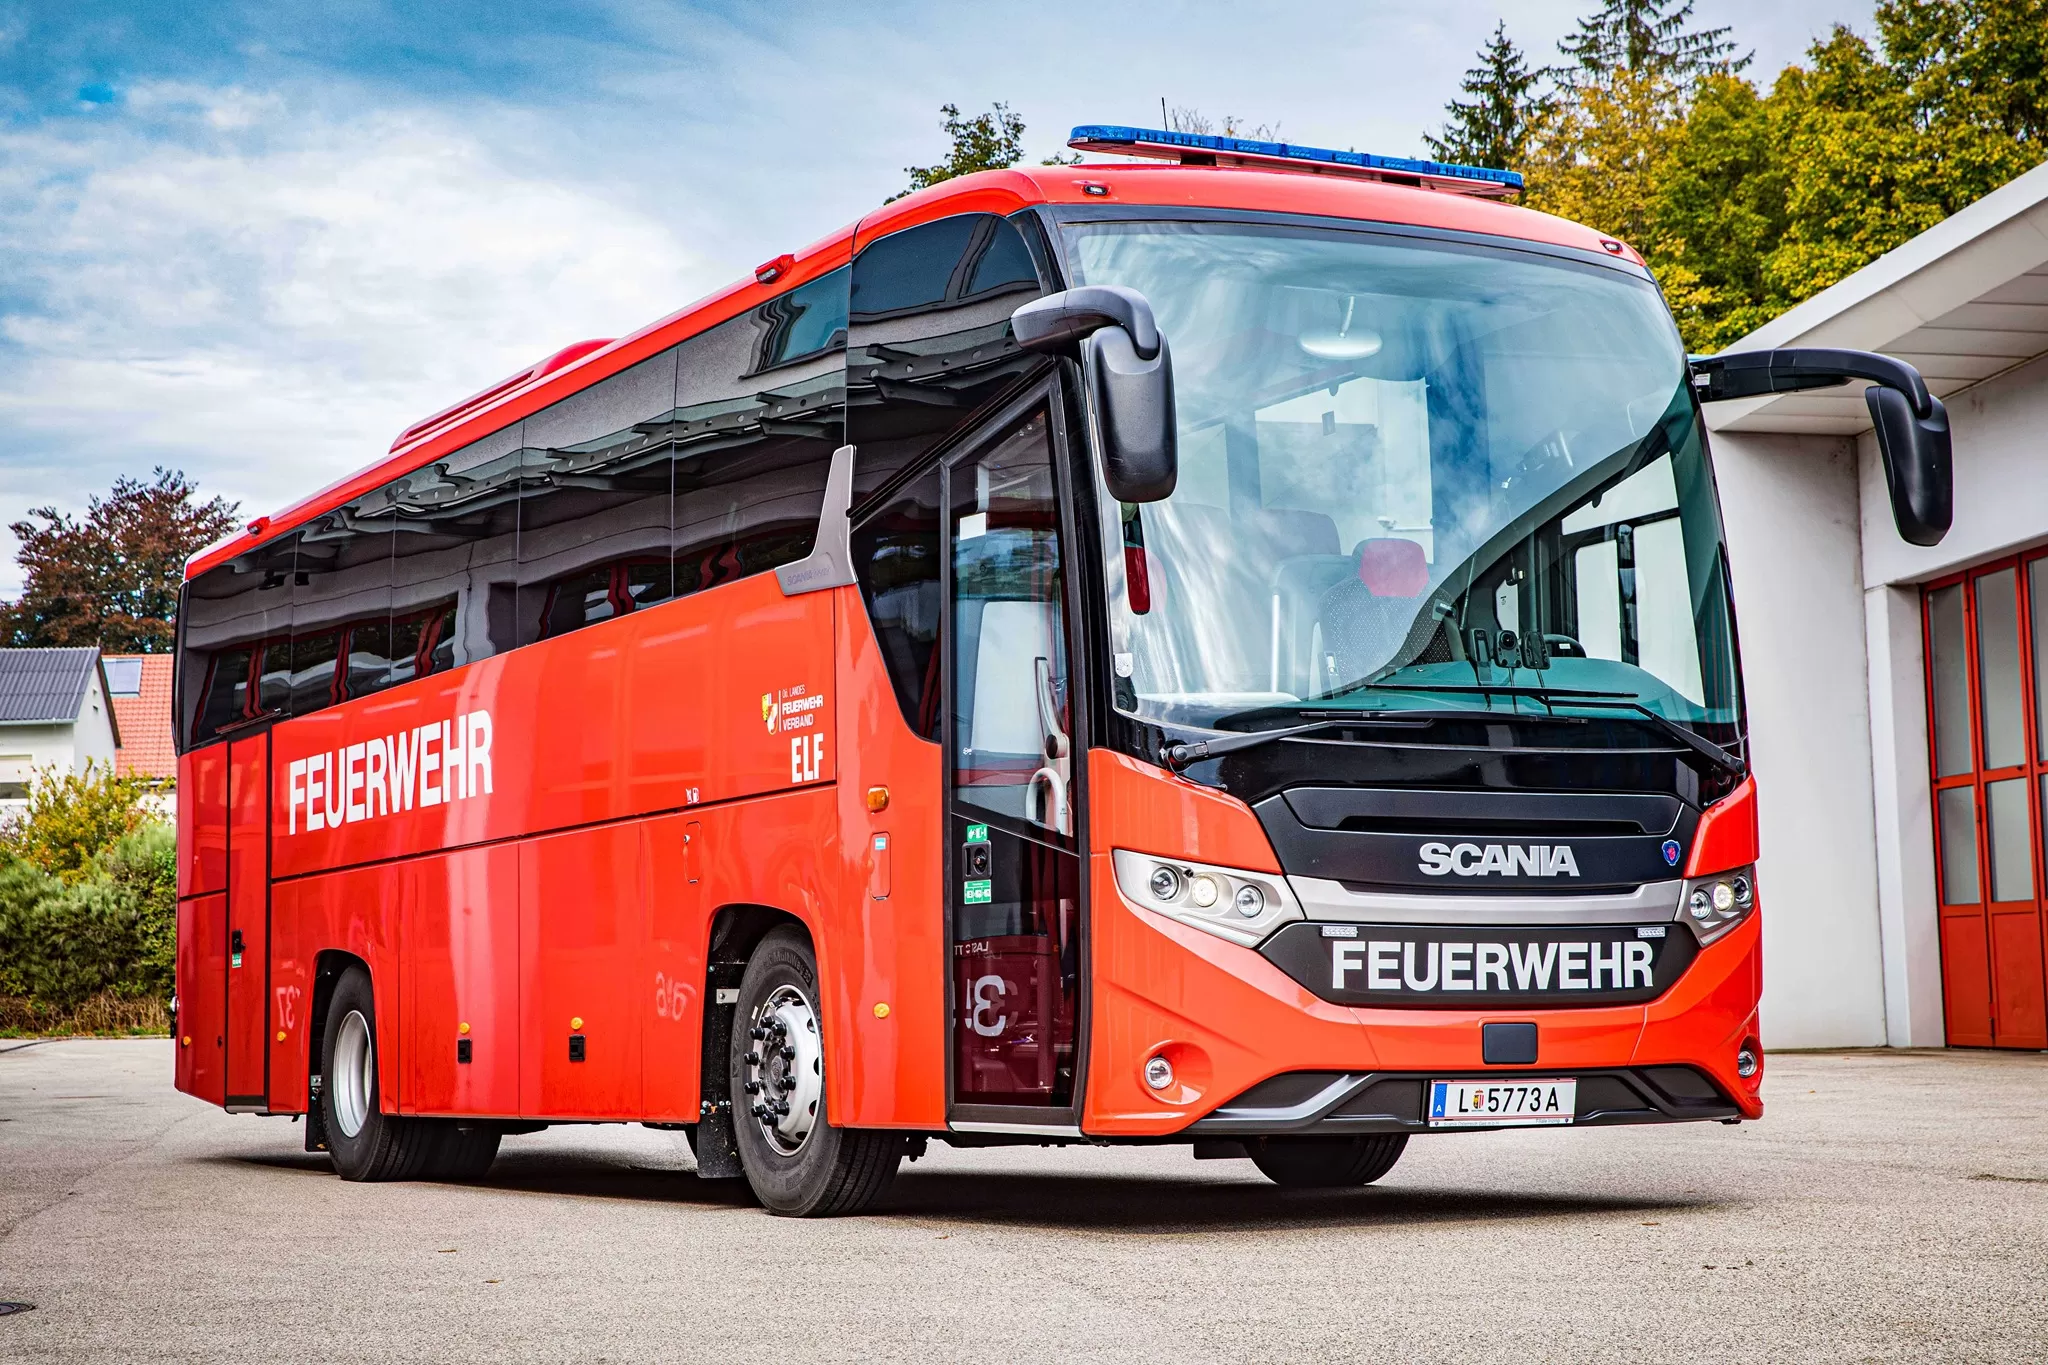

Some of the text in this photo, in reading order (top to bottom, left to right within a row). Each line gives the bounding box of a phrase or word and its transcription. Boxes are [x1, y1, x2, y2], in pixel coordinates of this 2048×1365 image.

[782, 694, 824, 716] FEUERWEHR
[789, 684, 806, 697] LANDES
[782, 713, 814, 731] VERBAND
[289, 709, 493, 836] FEUERWEHR
[791, 732, 824, 784] ELF
[1417, 842, 1580, 877] SCANIA
[1331, 940, 1654, 991] FEUERWEHR
[1435, 1104, 1442, 1113] A
[1458, 1088, 1468, 1113] L
